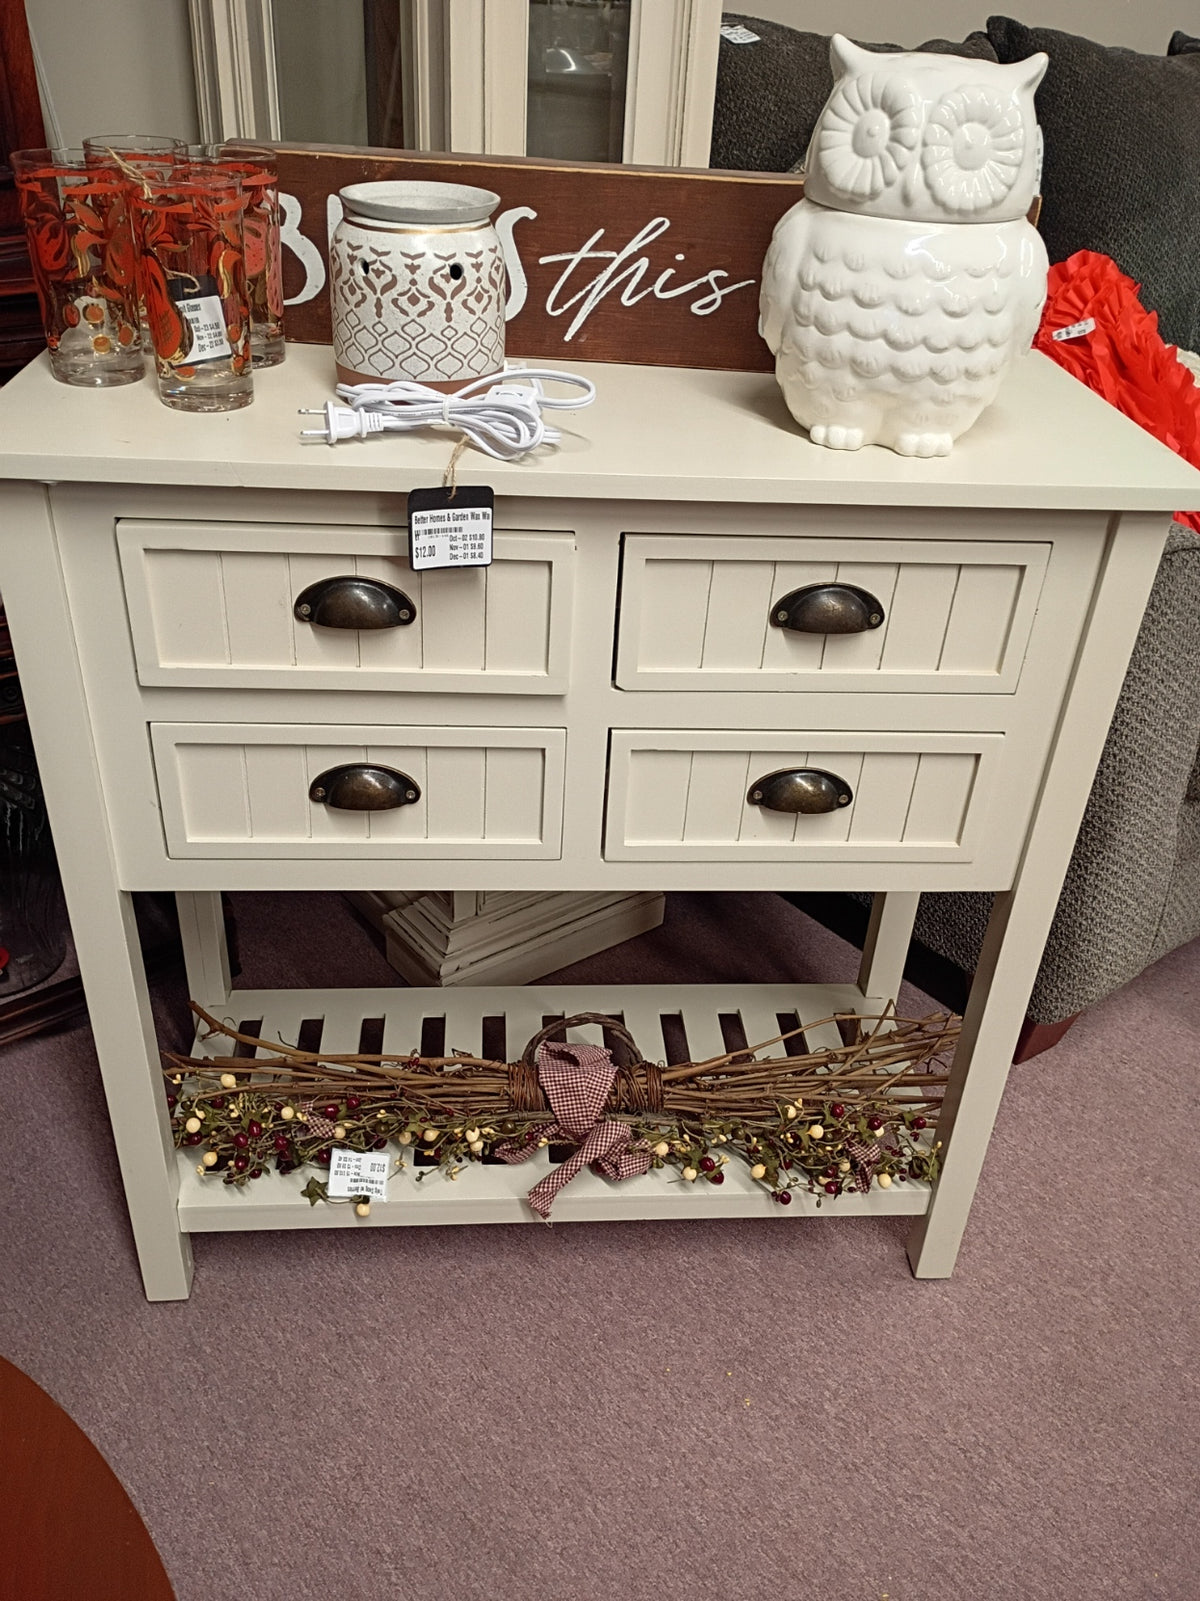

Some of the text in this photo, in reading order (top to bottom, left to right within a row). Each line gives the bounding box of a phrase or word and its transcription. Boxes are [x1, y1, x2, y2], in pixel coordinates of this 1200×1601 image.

[538, 216, 756, 342] this
[414, 511, 490, 524] Better Homes & Garden Wax Wa
[449, 534, 457, 542] Oct
[469, 533, 485, 541] $10.80
[415, 545, 436, 559] $12.00
[449, 553, 459, 561] Dec
